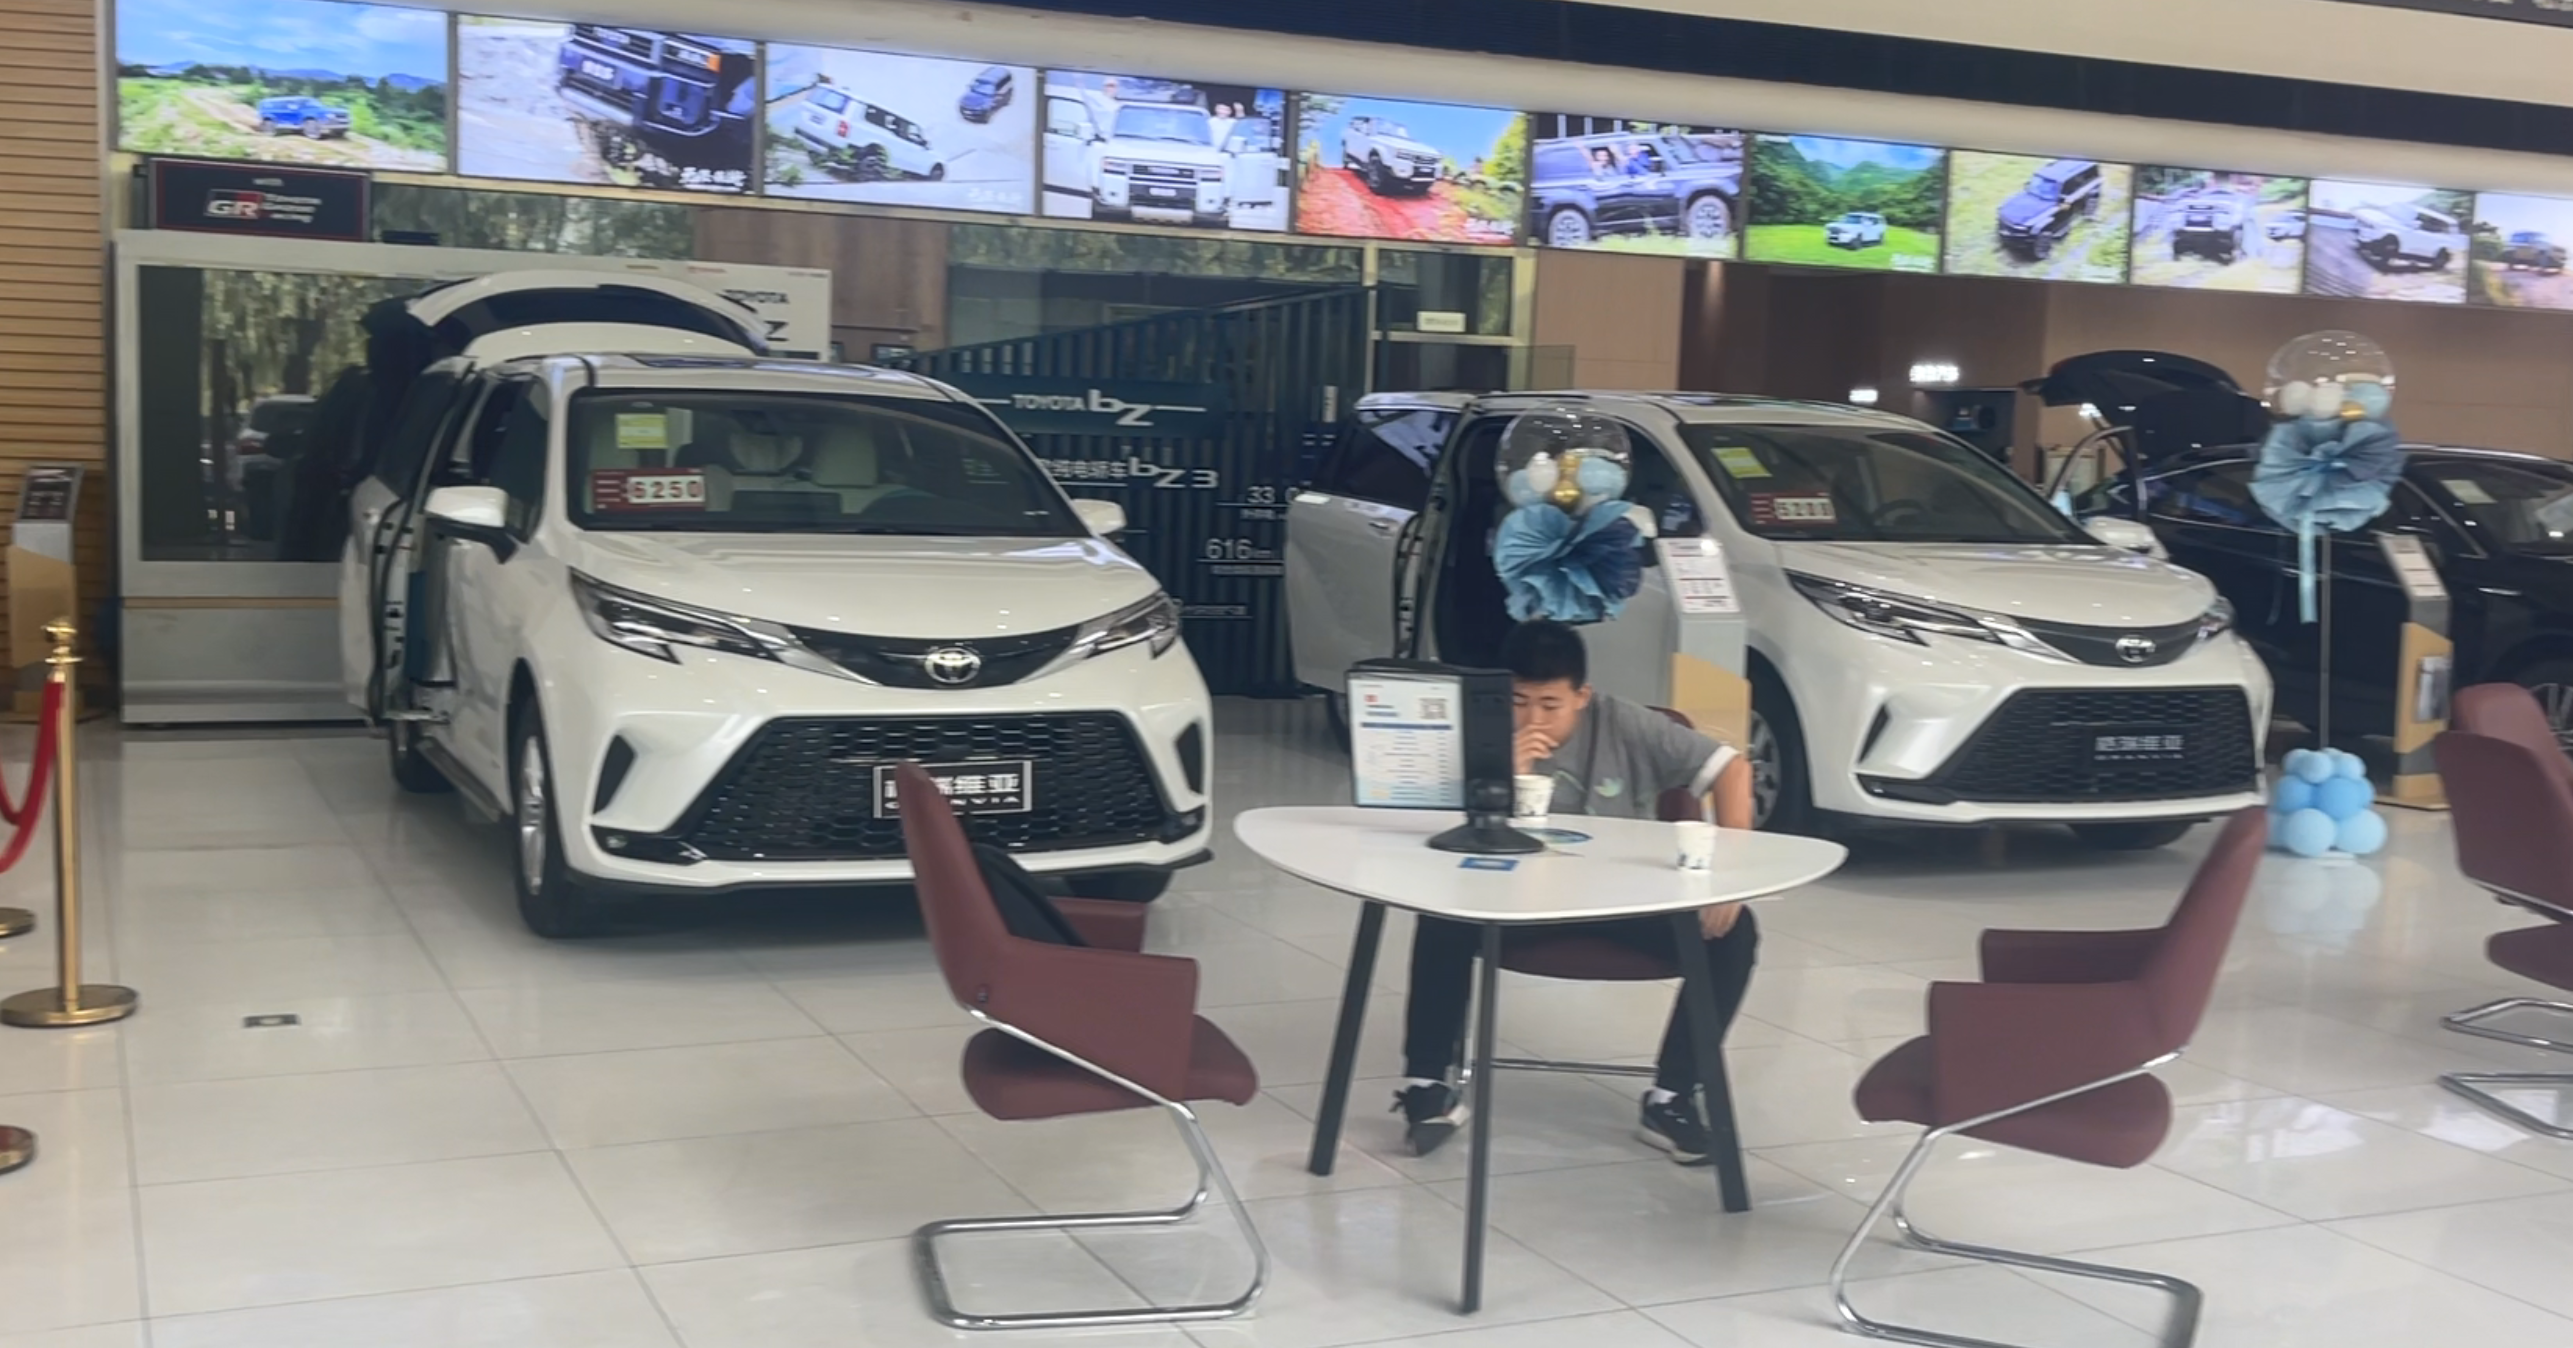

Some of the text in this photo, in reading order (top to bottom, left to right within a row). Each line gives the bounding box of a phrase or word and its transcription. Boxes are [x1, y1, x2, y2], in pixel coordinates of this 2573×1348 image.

[206, 199, 259, 219] GR
[722, 288, 790, 304] TOYOTA
[1011, 393, 1087, 411] TOYOTA
